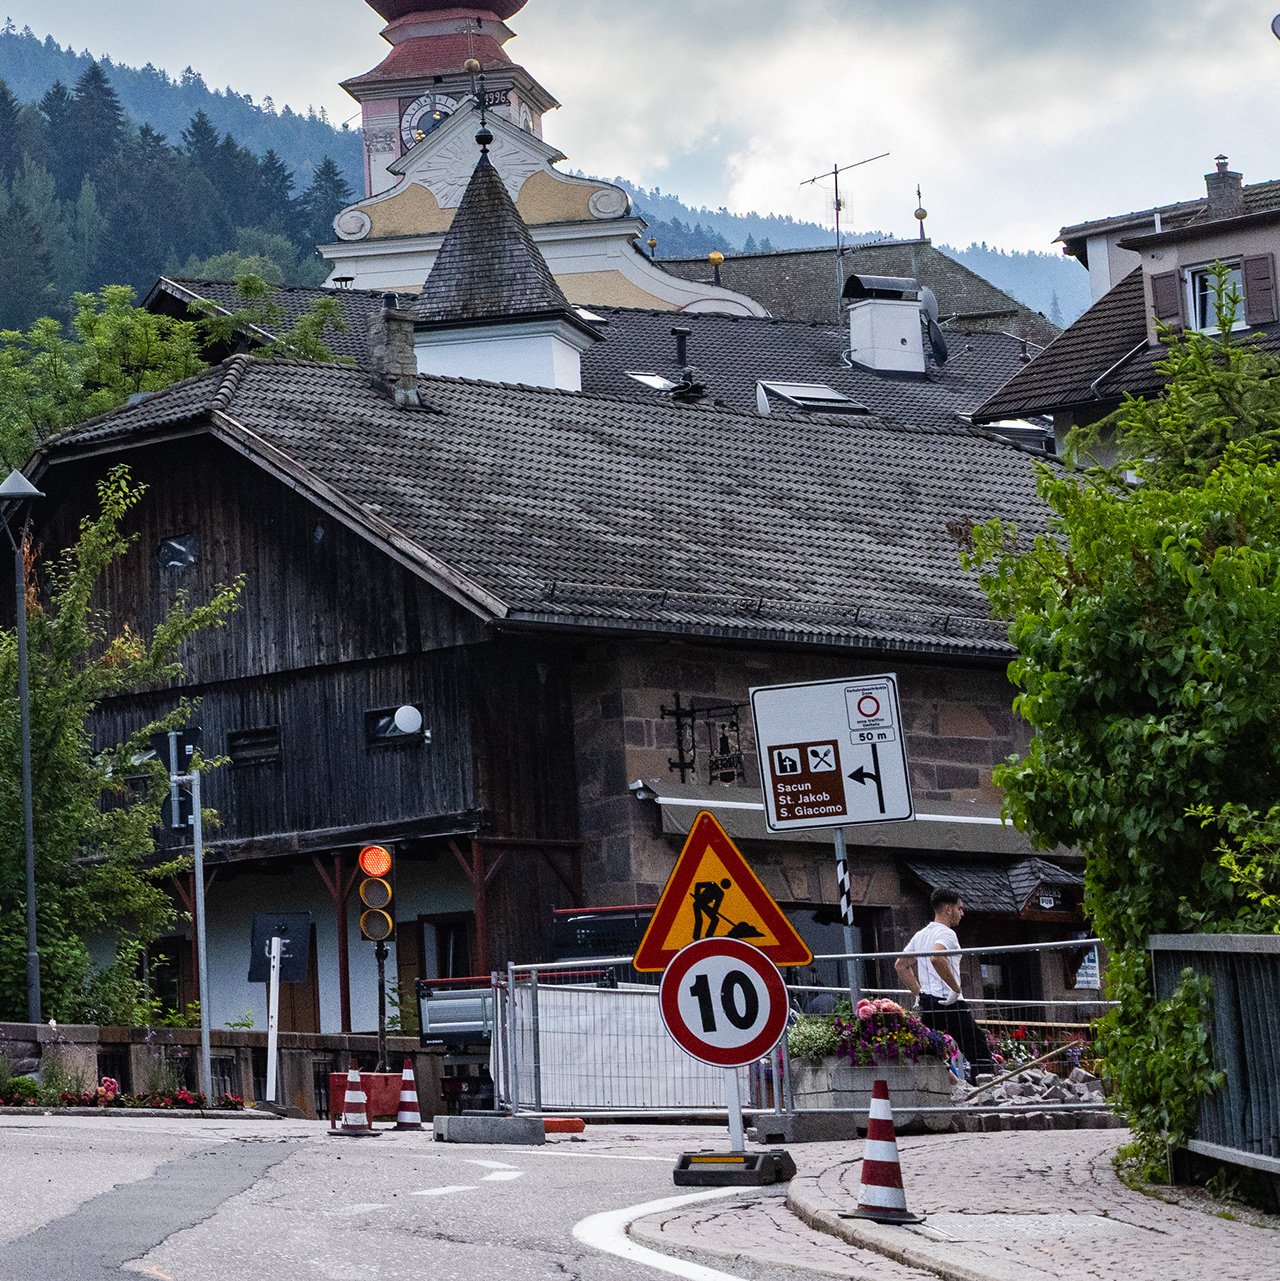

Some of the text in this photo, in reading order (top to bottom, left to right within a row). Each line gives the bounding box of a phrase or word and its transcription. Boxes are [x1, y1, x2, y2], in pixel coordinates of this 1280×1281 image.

[484, 91, 506, 105] 1996
[859, 732, 874, 741] 50
[777, 783, 812, 793] Sacun
[779, 792, 830, 805] St. Jakob
[780, 804, 843, 817] S. Giacomo
[690, 970, 759, 1033] 10
